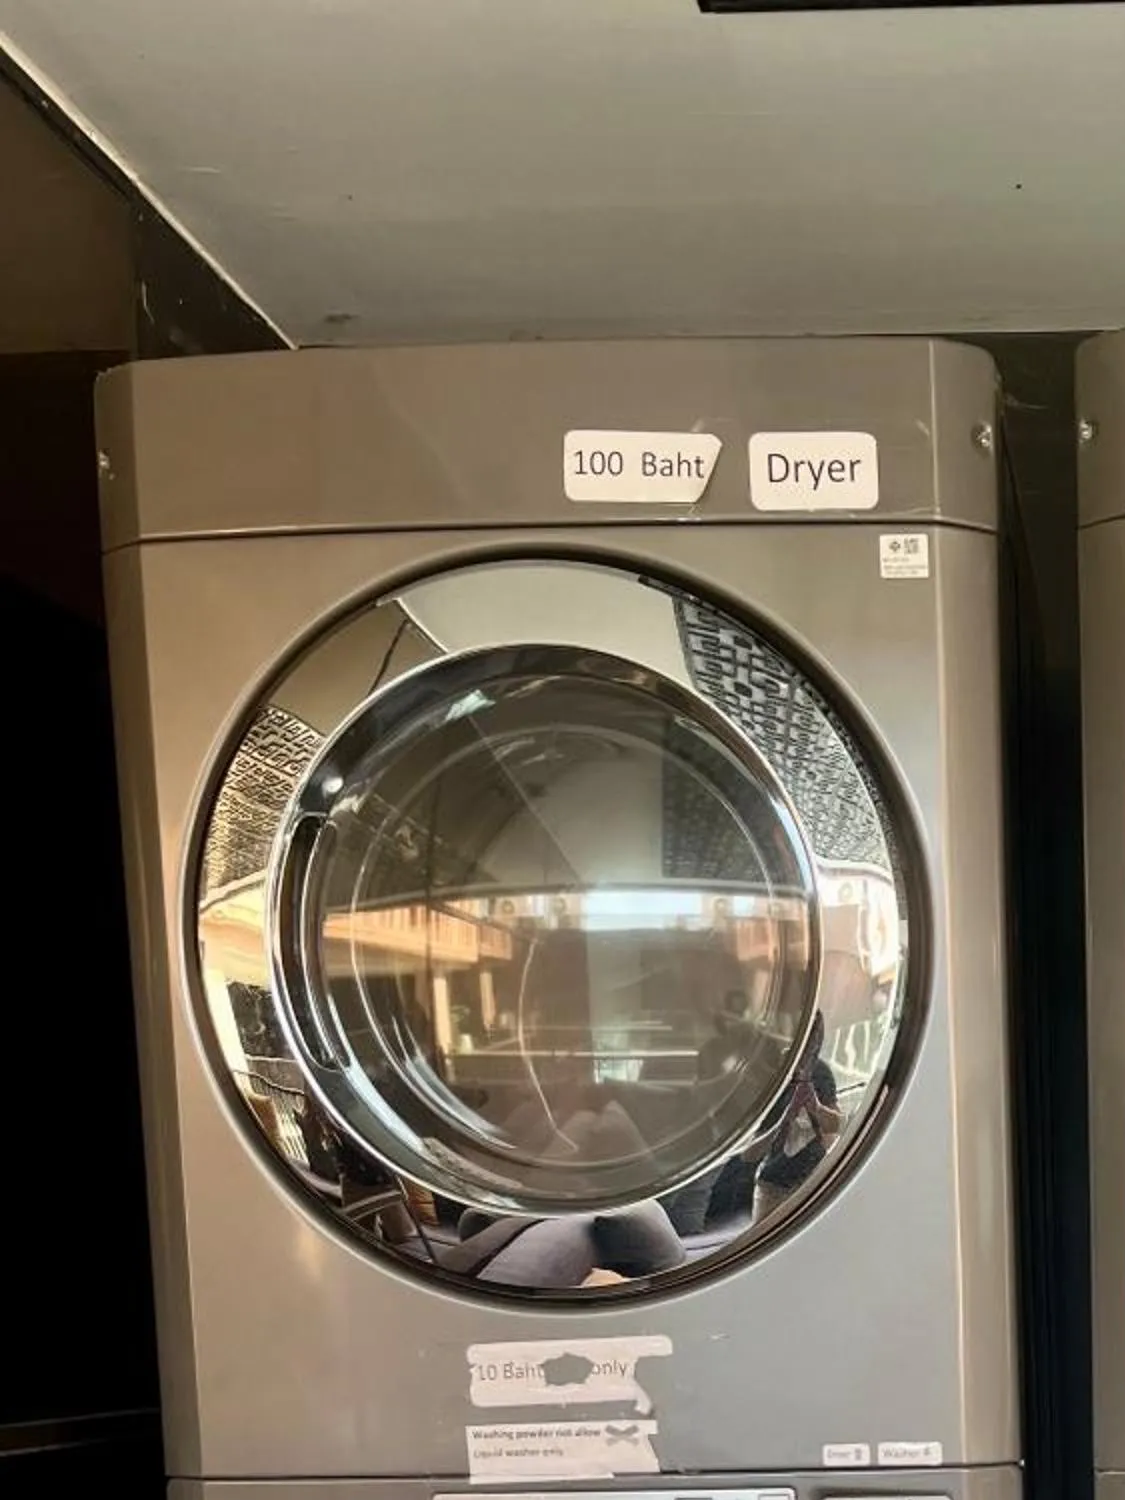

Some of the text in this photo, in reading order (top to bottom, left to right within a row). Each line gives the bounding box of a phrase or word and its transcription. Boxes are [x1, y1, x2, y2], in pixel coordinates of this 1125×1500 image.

[572, 450, 706, 480] 100 Baht
[766, 452, 863, 491] Dryer
[477, 1363, 498, 1381] 10
[472, 1428, 514, 1441] Washing
[516, 1428, 553, 1440] powder
[555, 1427, 573, 1438] not
